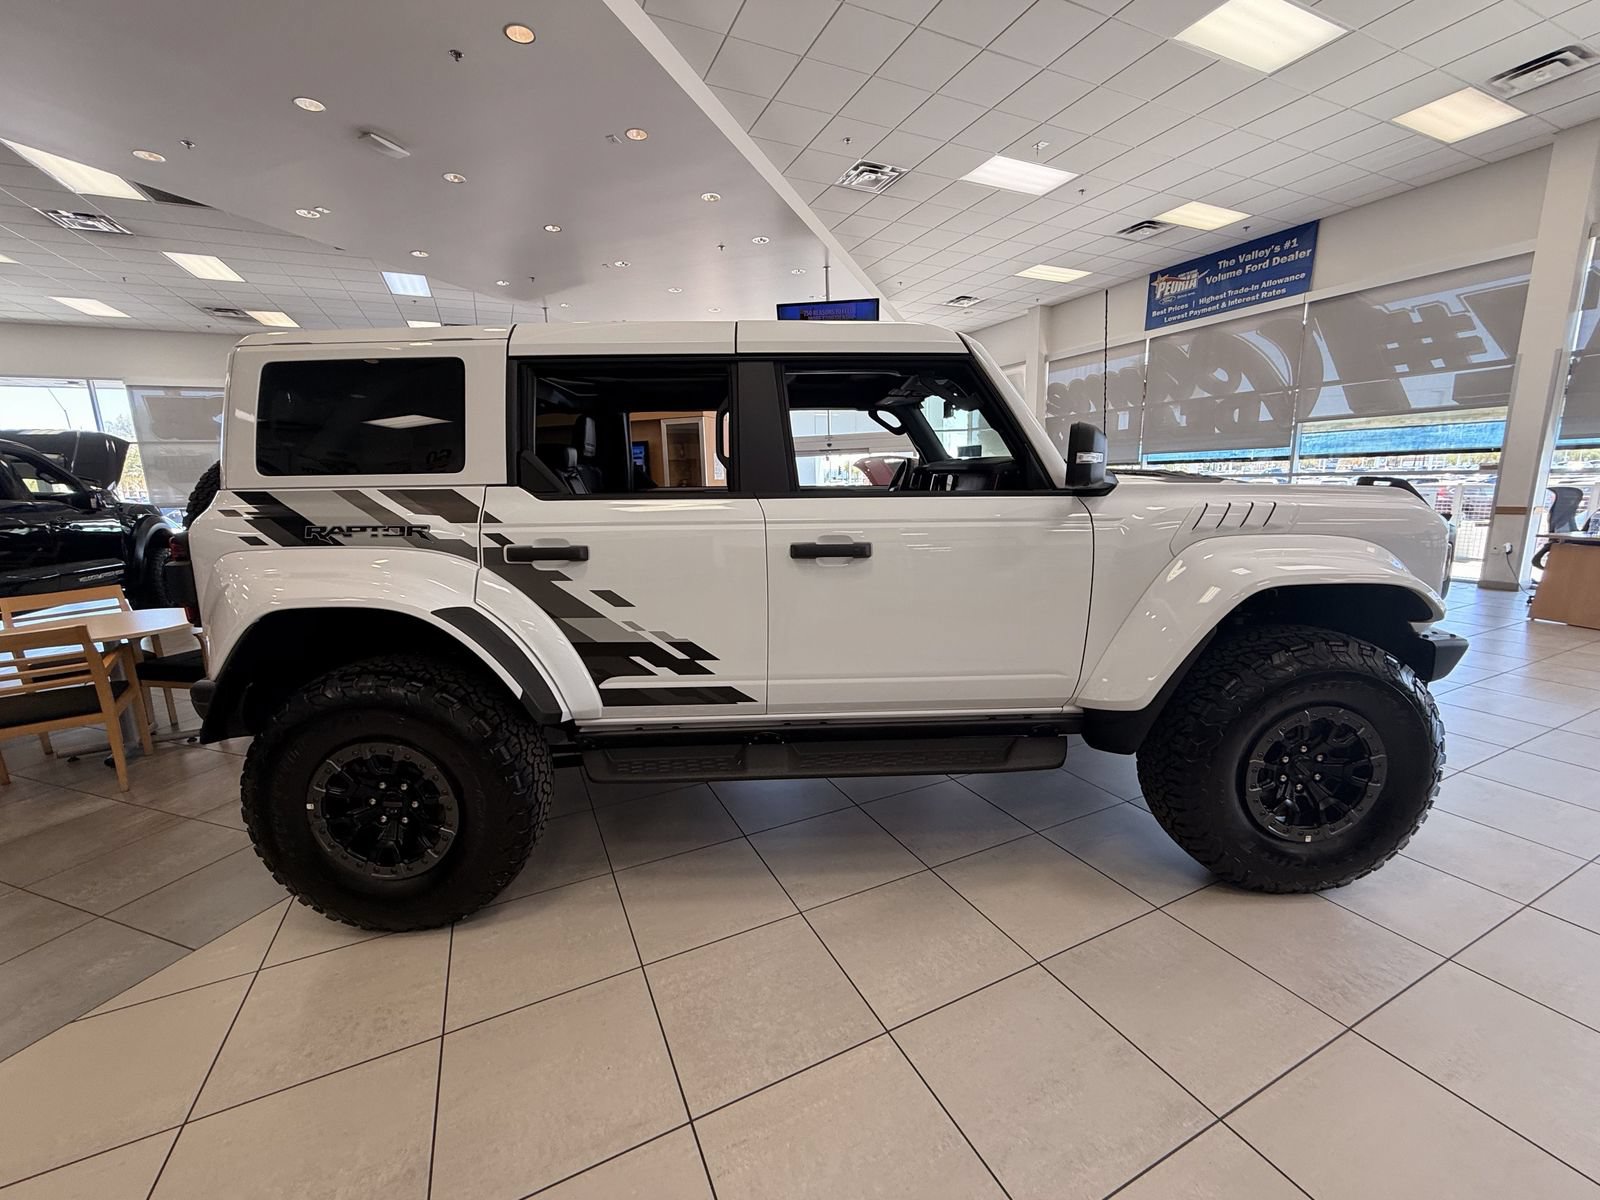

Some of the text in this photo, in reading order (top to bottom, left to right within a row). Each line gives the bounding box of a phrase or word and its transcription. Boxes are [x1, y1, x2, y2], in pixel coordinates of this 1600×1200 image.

[1205, 269, 1243, 285] Volume
[1244, 260, 1269, 274] Ford
[1272, 249, 1313, 267] Dealer
[1217, 238, 1299, 270] The Valley's #1
[1151, 308, 1167, 318] Best
[1167, 303, 1189, 313] Prices
[1199, 291, 1227, 305] Highest
[1227, 284, 1260, 296] Trade-In
[1261, 272, 1306, 289] Allowance
[1164, 287, 1287, 323] Lowest Payment & Interest Rates
[304, 523, 433, 545] RAPTOR
